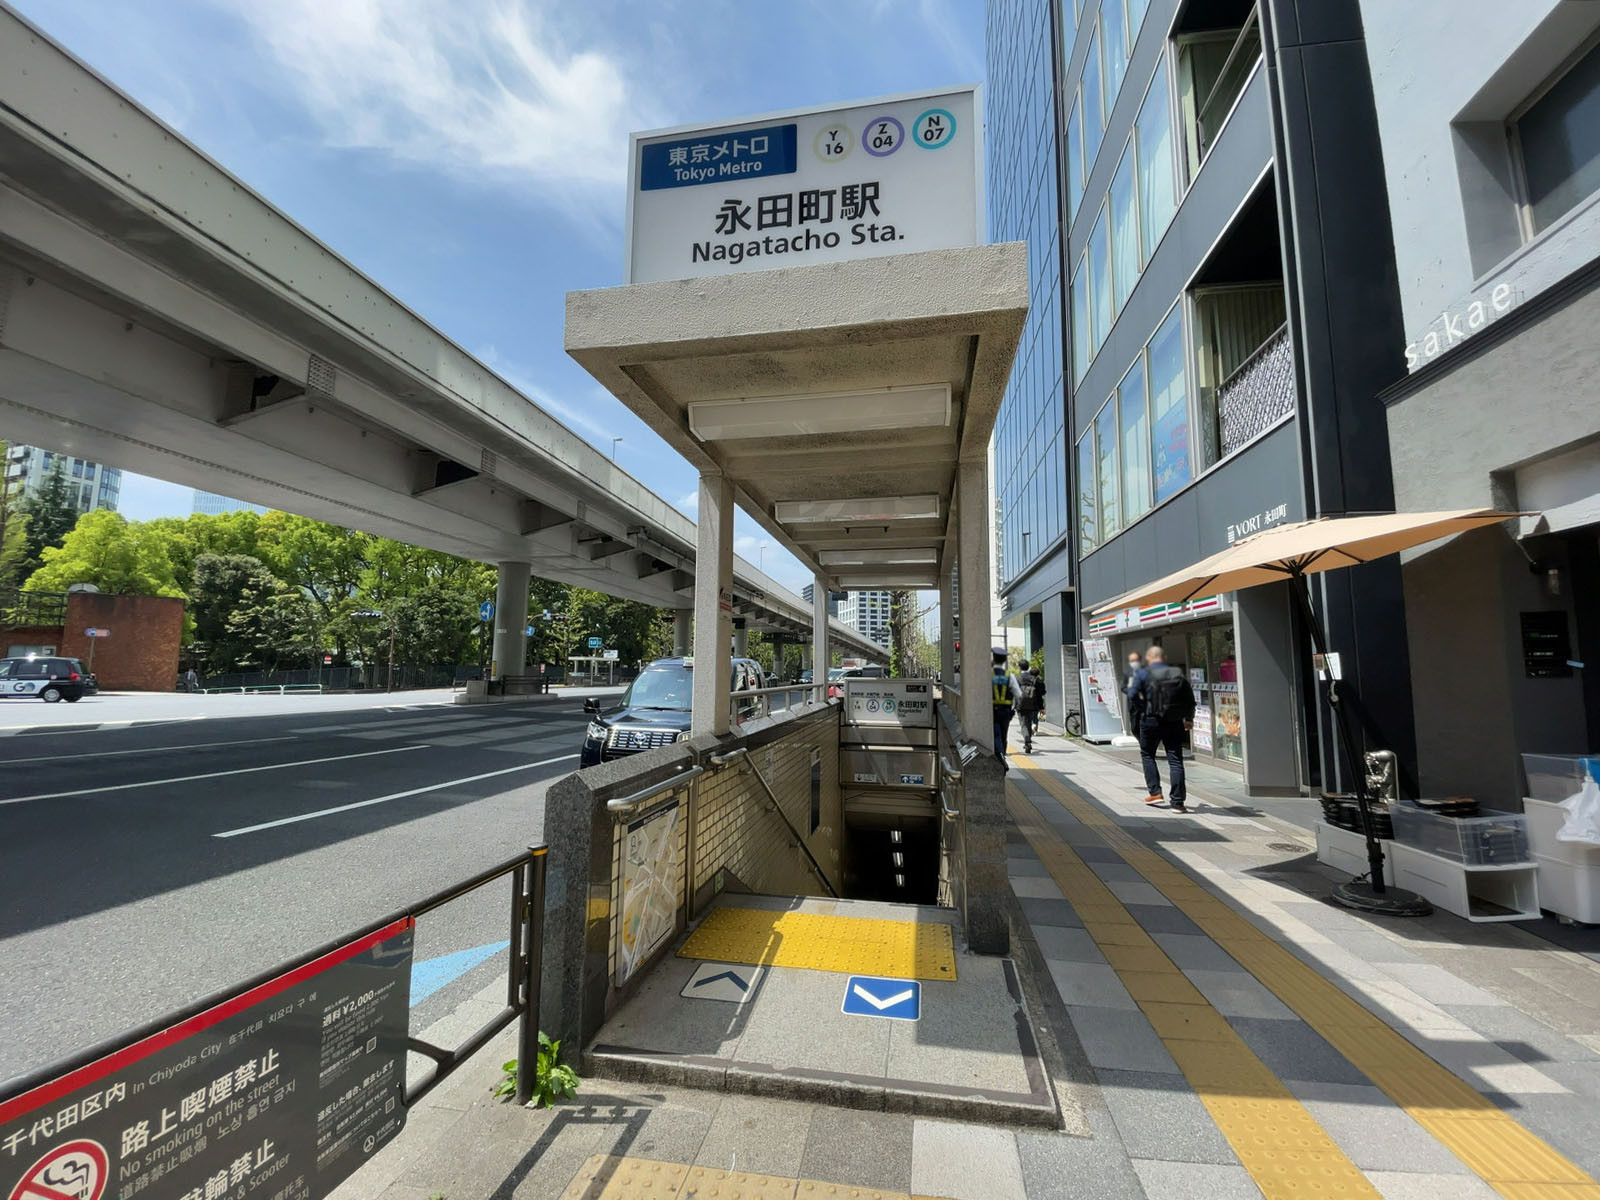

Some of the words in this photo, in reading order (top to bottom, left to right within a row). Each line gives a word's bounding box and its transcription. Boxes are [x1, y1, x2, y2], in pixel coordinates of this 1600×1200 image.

[829, 130, 839, 141] Y
[878, 123, 887, 134] Z
[923, 127, 945, 142] 07
[928, 116, 940, 127] N
[668, 135, 769, 167] 東京メトロ
[825, 142, 844, 155] 16
[873, 135, 894, 149] 04
[674, 166, 716, 181] Tokyo
[719, 160, 762, 176] Metro
[714, 181, 880, 235] 永田町駅
[692, 228, 840, 265] Nagatacho
[851, 222, 905, 245] Sta.
[1405, 283, 1511, 368] sakae
[1236, 514, 1262, 537] VORT
[1264, 503, 1287, 525] 永田町
[343, 990, 374, 1015] ¥2,000
[1, 1081, 127, 1156] 千代田区内
[133, 1082, 145, 1094] In
[149, 1055, 197, 1086] Chiyoda
[200, 1043, 222, 1058] City
[120, 1048, 280, 1159] 路上喫煙禁止
[120, 1160, 141, 1182] No
[145, 1122, 204, 1163] smoking
[206, 1111, 223, 1128] on
[225, 1097, 245, 1116] the
[247, 1074, 280, 1103] street
[249, 1153, 290, 1191] Scooter
